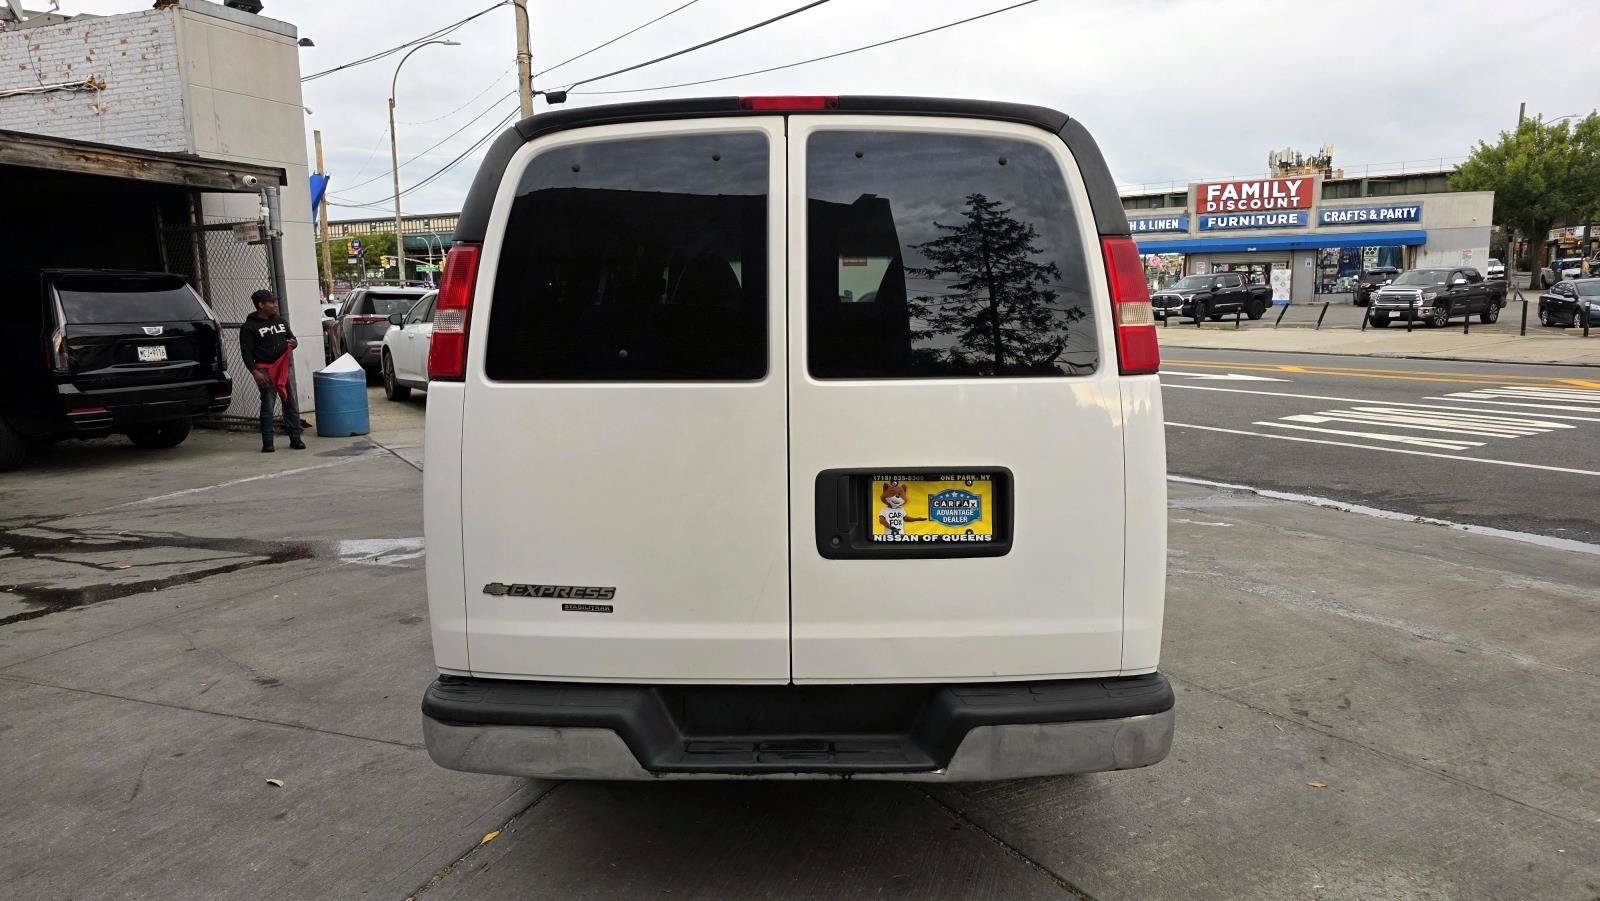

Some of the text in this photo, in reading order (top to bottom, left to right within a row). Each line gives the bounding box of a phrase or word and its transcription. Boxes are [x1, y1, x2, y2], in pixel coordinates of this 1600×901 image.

[1207, 179, 1303, 201] FAMILY
[1207, 196, 1300, 212] DISCOUNT
[1207, 213, 1298, 228] FURNITURE
[1324, 207, 1417, 222] CRAFTS & PARTY
[1139, 220, 1146, 230] &
[1148, 218, 1179, 230] LINEN
[258, 323, 286, 338] PYLE
[933, 499, 977, 508] CARFAX
[936, 508, 974, 516] ADVANTAGE
[874, 534, 992, 542] NISSAN OF QUEENS
[510, 584, 615, 599] EXPRESS
